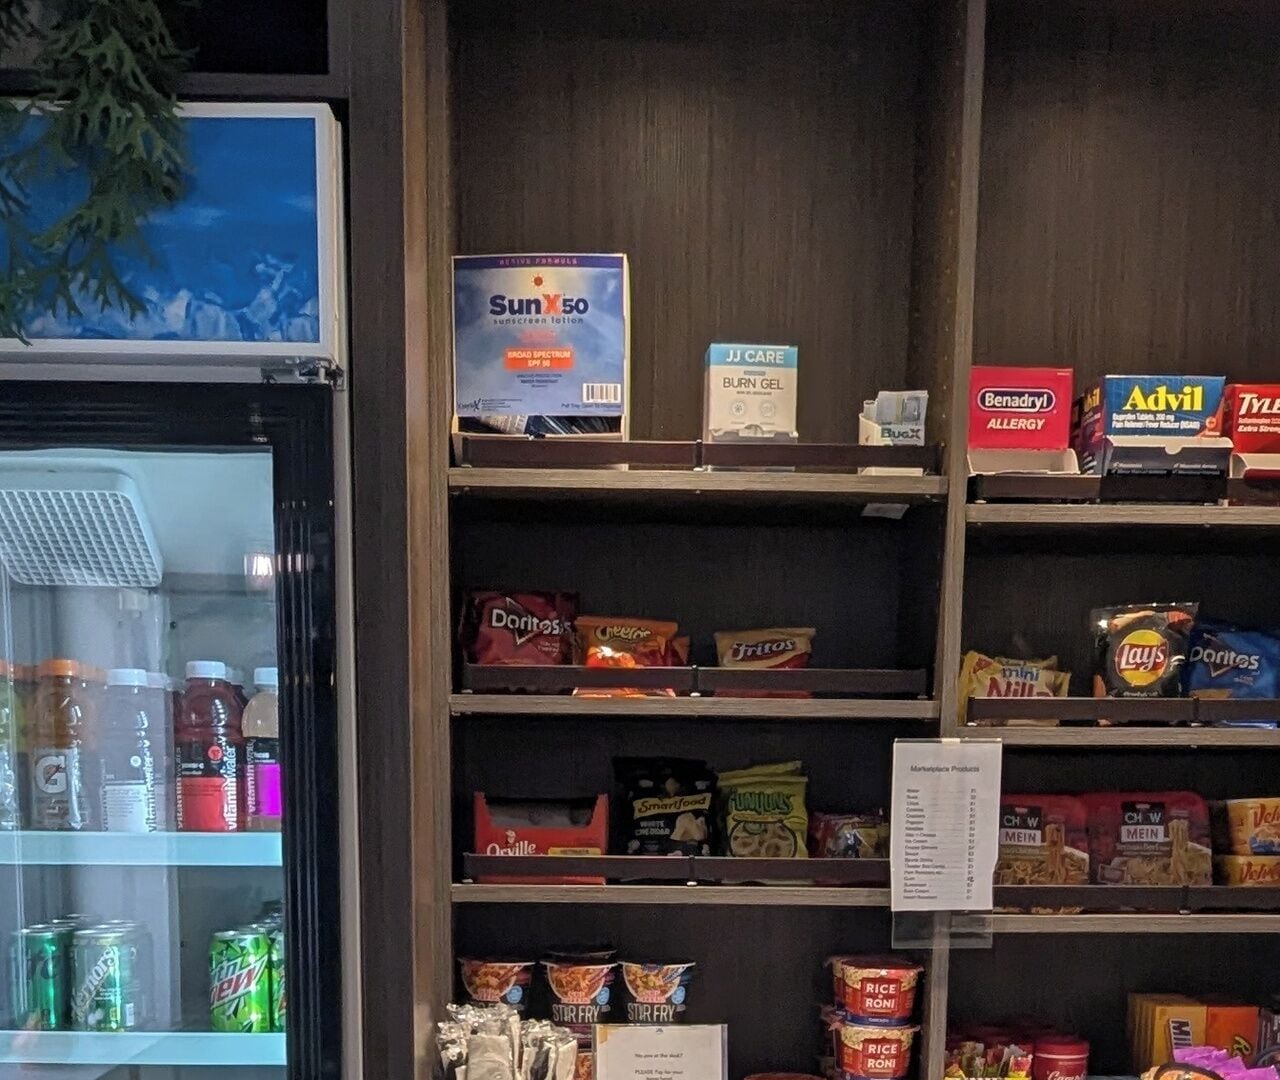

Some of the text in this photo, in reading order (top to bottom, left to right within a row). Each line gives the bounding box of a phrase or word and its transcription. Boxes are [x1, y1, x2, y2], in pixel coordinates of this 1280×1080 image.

[493, 316, 584, 325] sunscreen lotion
[726, 350, 784, 364] JJ CARE
[722, 376, 784, 390] BURN GEL
[985, 392, 1048, 412] Benadryl
[1122, 384, 1203, 411] Advil
[986, 418, 1046, 430] ALLERGY
[491, 609, 559, 635] Doritos
[731, 638, 796, 660] Fritos
[1189, 646, 1260, 670] Doritos
[1002, 666, 1040, 682] mini
[35, 755, 70, 795] G
[951, 765, 980, 773] Products
[637, 797, 707, 814] Smartfood
[635, 828, 670, 836] CHEDDAR
[640, 821, 664, 830] WHITE
[1005, 830, 1037, 844] MEIN
[1126, 828, 1159, 840] MEIN
[486, 840, 536, 855] Orville
[866, 983, 897, 994] RICE
[865, 998, 895, 1009] RONI
[579, 1005, 600, 1022] FRY
[653, 1004, 676, 1022] FRY
[868, 1044, 898, 1054] RICE
[867, 1059, 896, 1069] RONI
